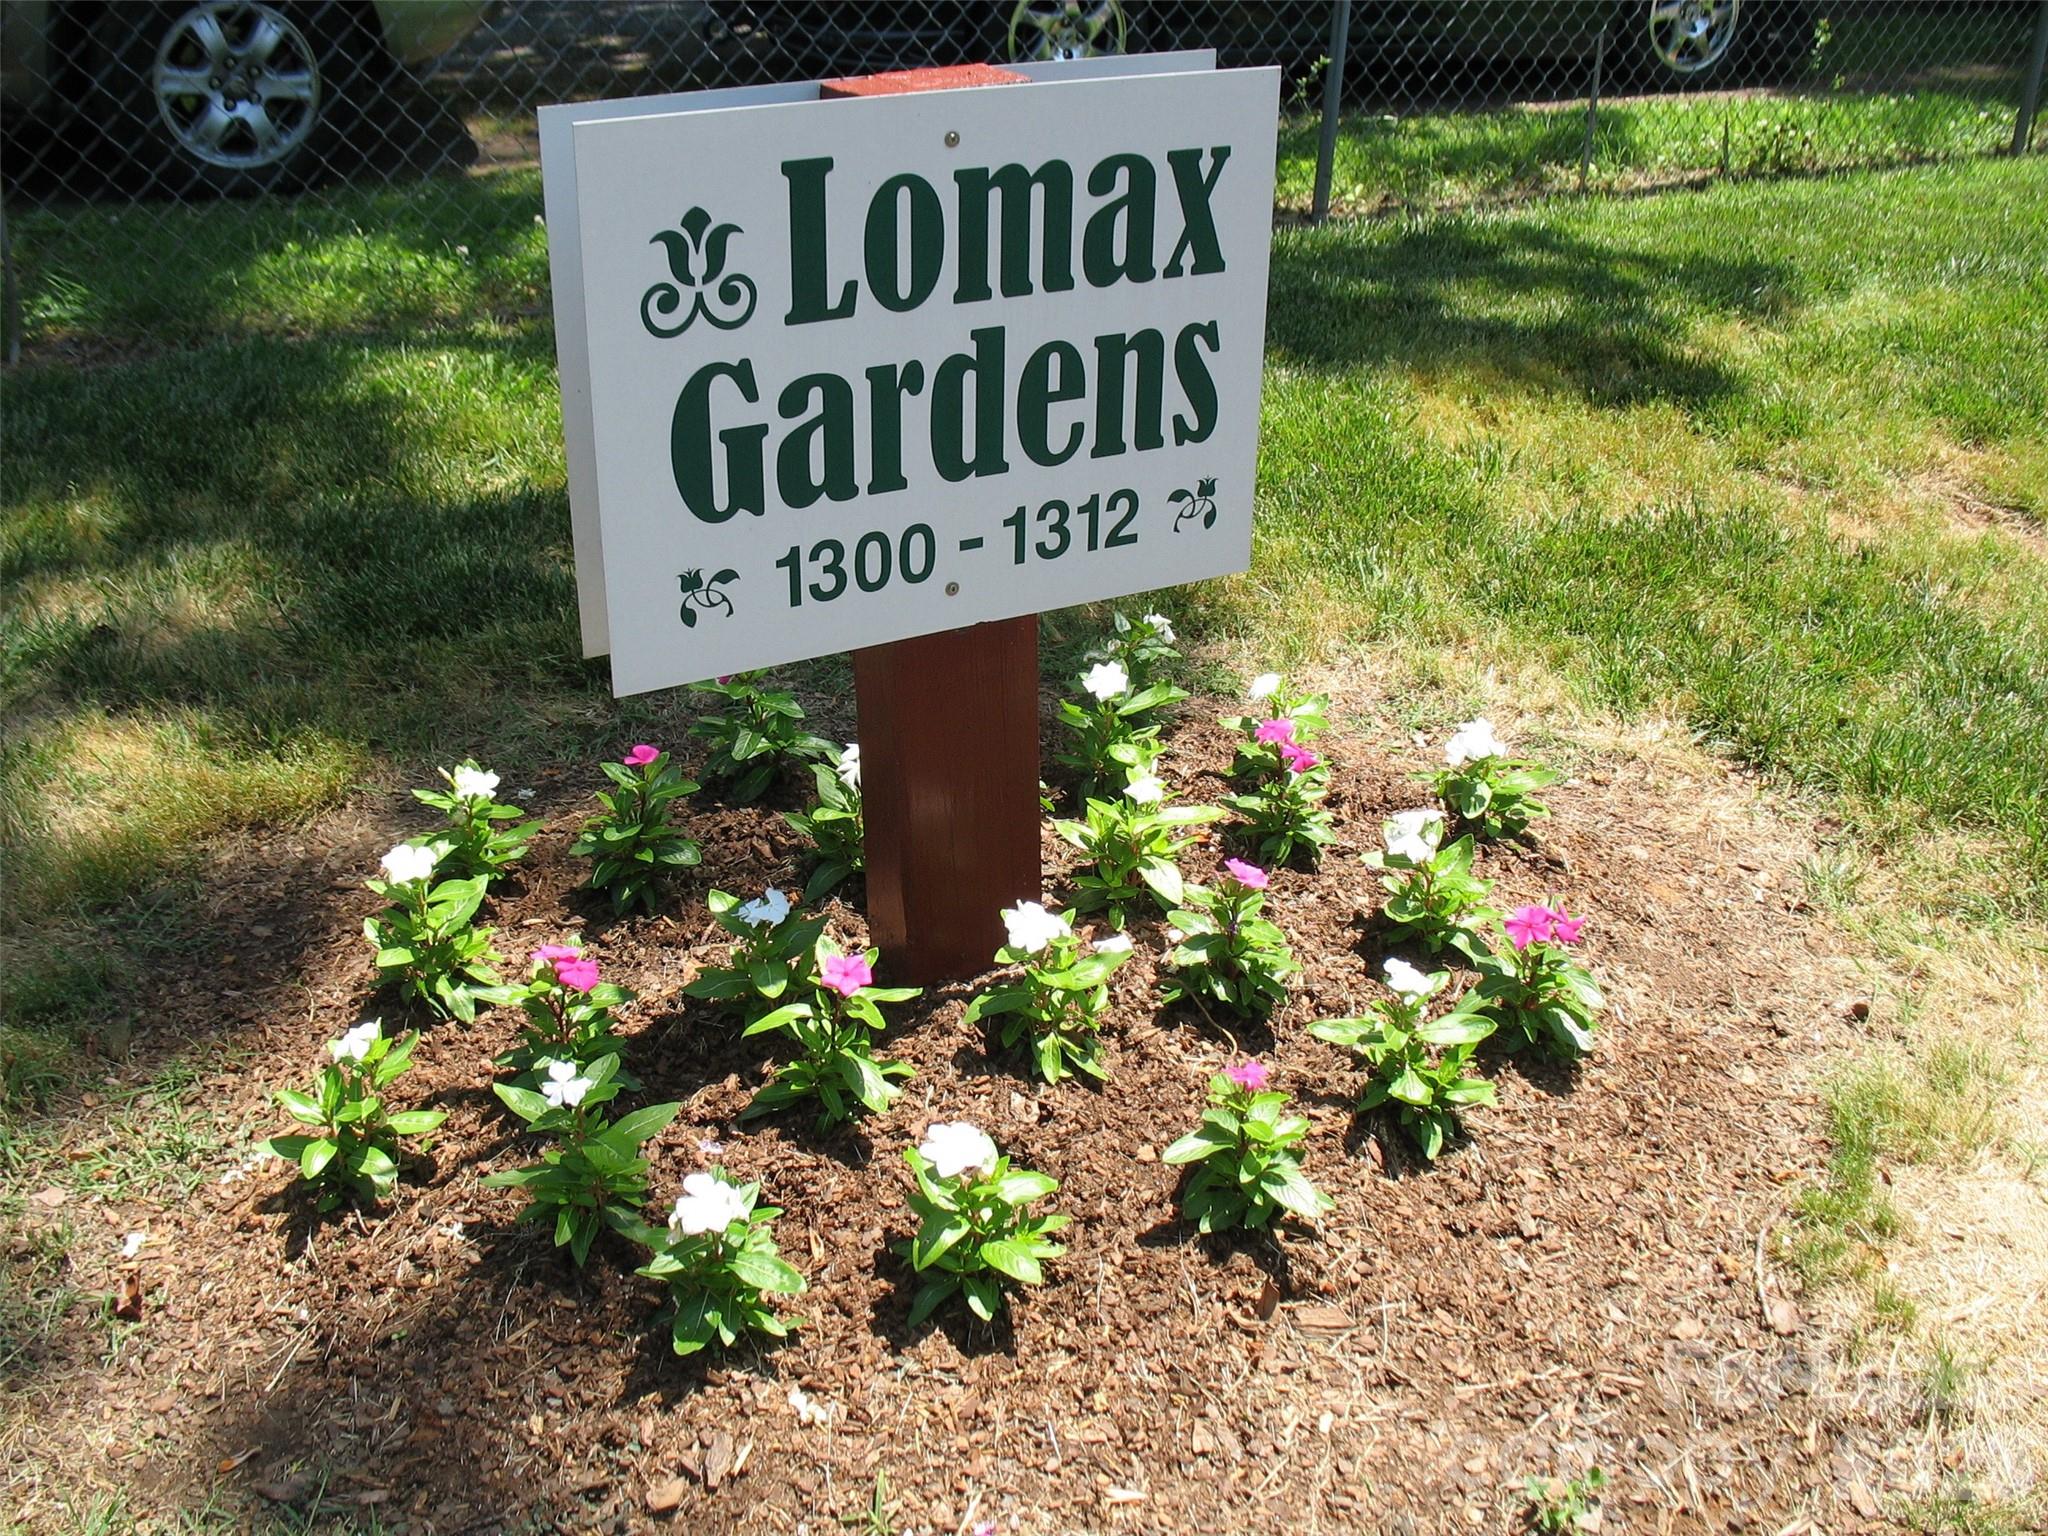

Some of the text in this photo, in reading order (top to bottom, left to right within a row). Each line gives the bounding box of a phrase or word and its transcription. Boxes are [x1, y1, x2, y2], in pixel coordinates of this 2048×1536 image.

[780, 145, 1232, 327] Lomax
[670, 319, 1221, 524] Gardens
[775, 522, 936, 608] 1300
[1002, 488, 1140, 566] 1312
